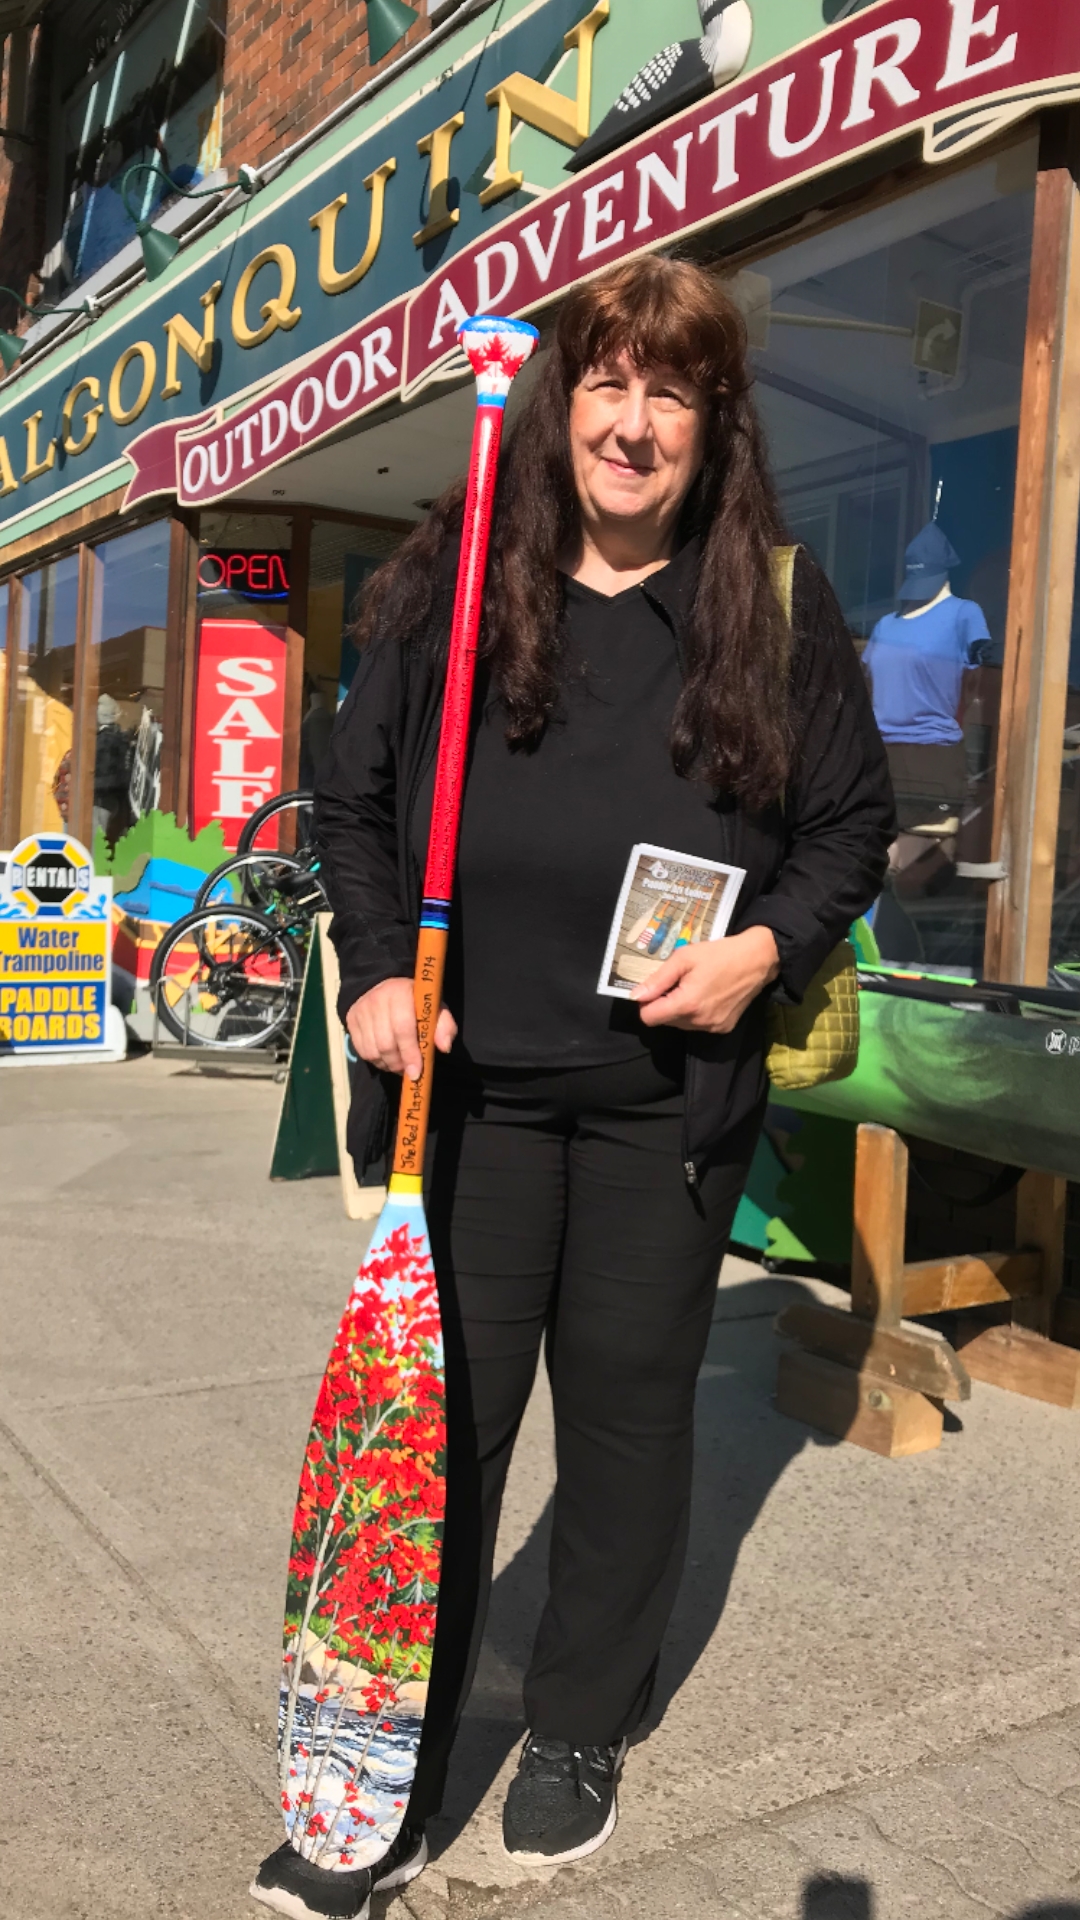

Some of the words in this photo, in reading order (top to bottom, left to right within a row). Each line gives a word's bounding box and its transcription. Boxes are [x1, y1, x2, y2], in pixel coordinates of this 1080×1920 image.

[182, 326, 398, 494] OUTDOOR
[428, 0, 1018, 349] ADVENTURE
[197, 553, 290, 589] OPEN
[207, 657, 281, 818] SALE
[12, 866, 90, 889] RENTALS
[17, 926, 79, 948] Water
[0, 950, 104, 974] rampoline
[421, 955, 436, 982] 1914
[0, 986, 97, 1013] PADDLE
[417, 993, 433, 1049] Jackson
[402, 1124, 418, 1148] Red
[400, 1147, 416, 1168] The
